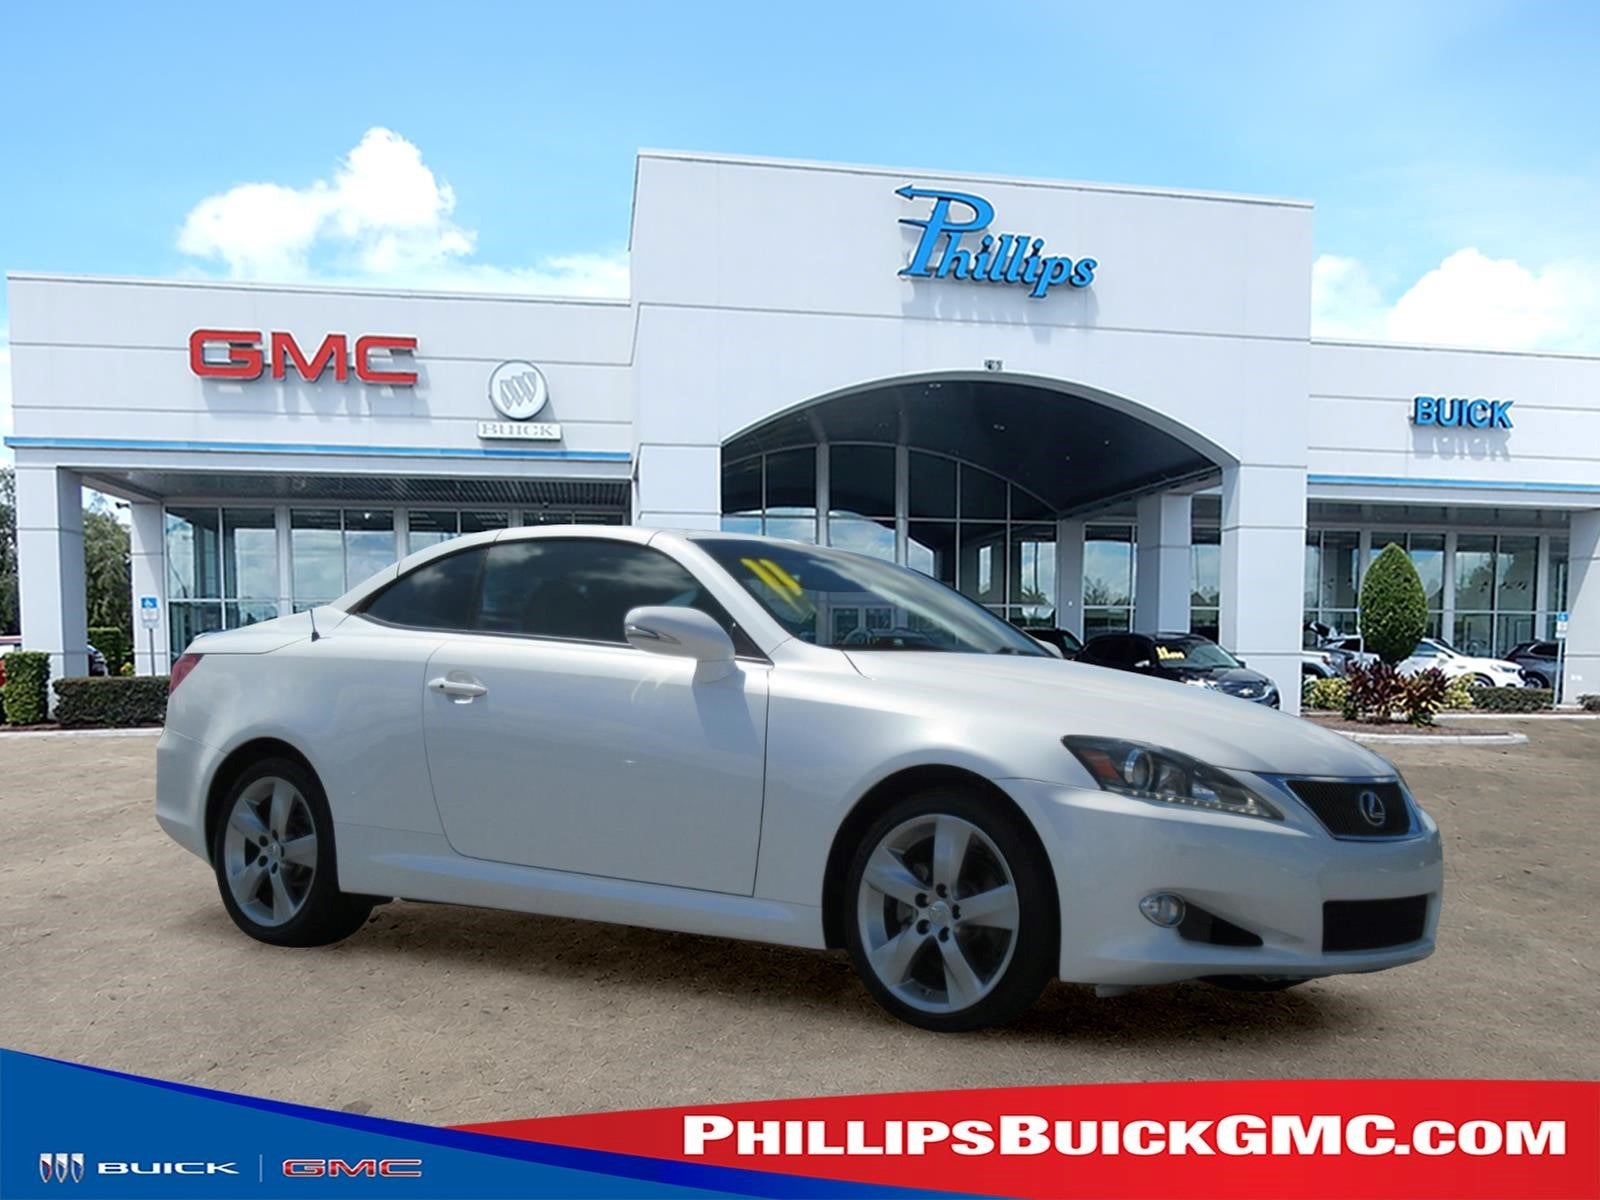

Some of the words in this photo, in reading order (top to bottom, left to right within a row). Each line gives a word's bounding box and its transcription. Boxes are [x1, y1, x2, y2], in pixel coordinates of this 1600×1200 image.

[895, 185, 1098, 298] Phillips
[189, 328, 418, 386] GMC
[482, 423, 554, 436] BUICK
[1413, 396, 1514, 428] BUICK
